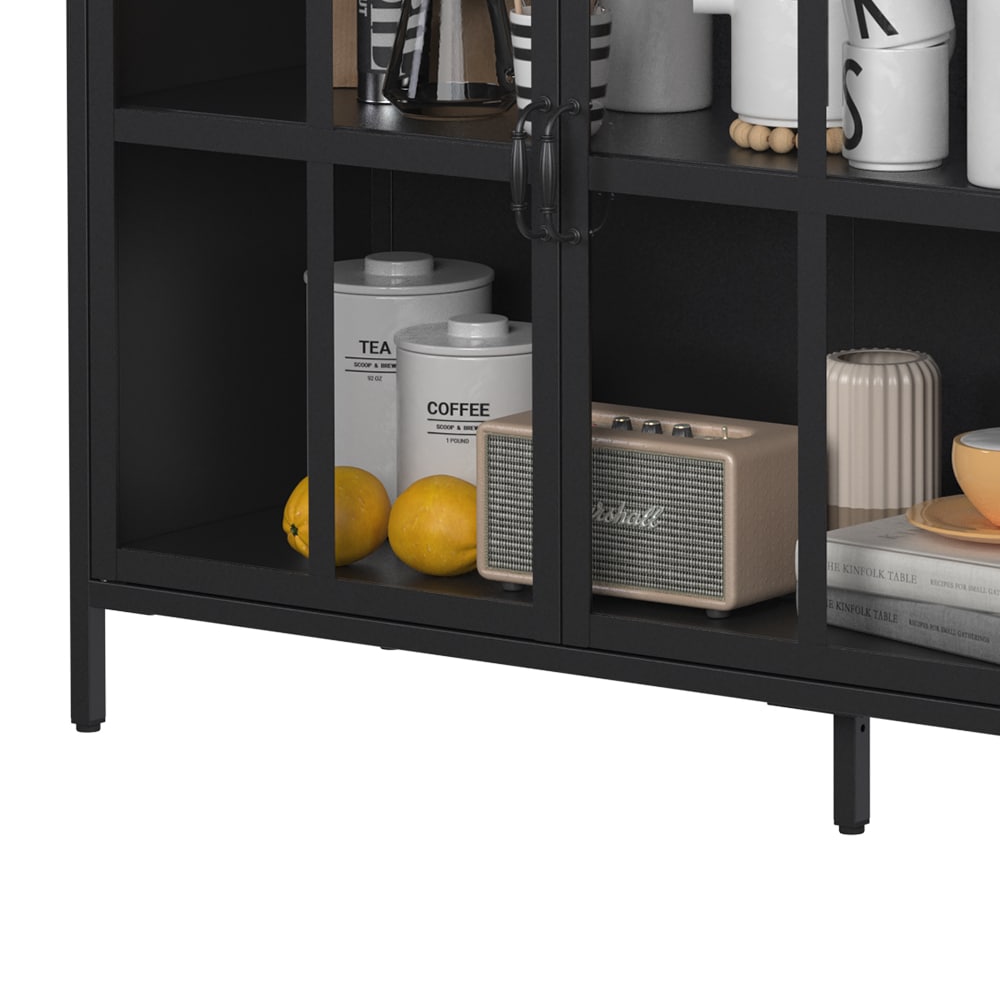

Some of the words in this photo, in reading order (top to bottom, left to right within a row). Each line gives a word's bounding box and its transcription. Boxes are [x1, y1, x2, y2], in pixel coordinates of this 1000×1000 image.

[842, 58, 863, 150] S
[359, 340, 392, 354] TEA
[427, 401, 490, 417] COFFEE
[842, 563, 886, 580] KINFOLK
[887, 570, 918, 585] TABLE
[835, 600, 872, 618] KINFOLK
[872, 609, 899, 624] TABLE
